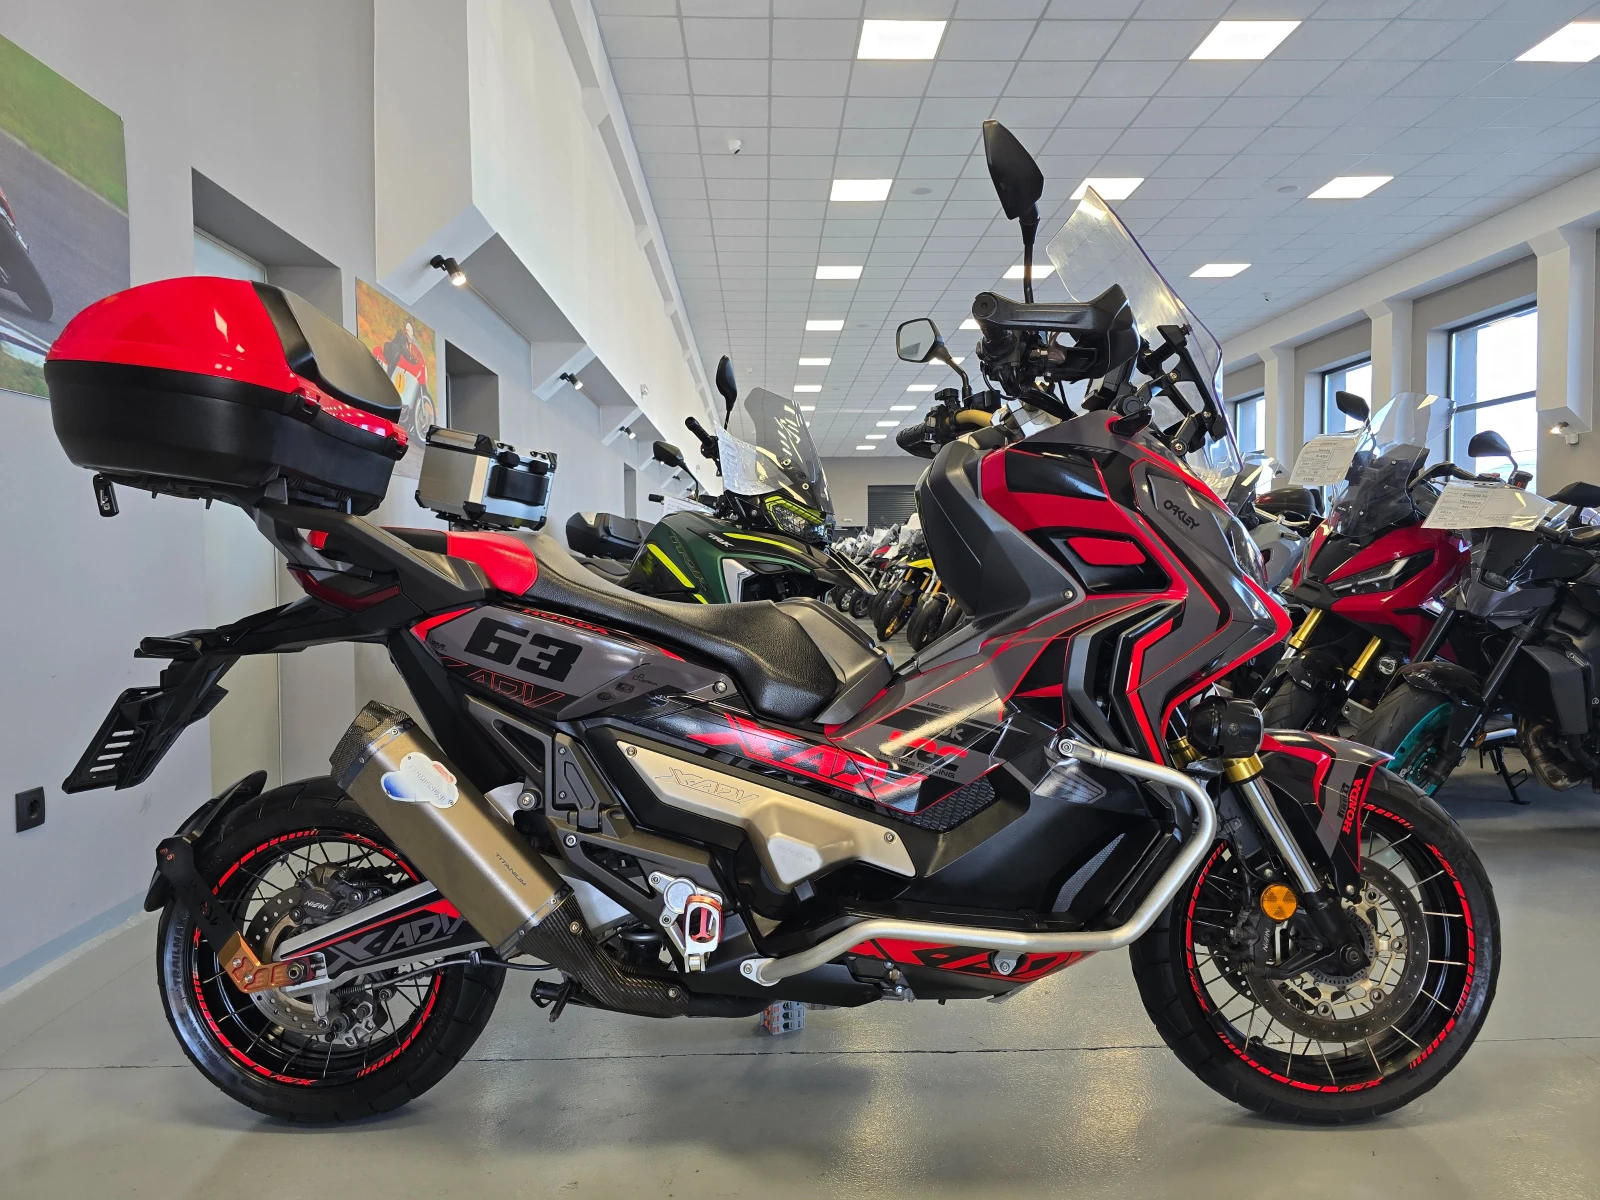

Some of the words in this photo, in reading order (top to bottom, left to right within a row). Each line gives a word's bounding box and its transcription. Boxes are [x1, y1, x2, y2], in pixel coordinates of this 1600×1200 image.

[1164, 500, 1199, 530] OAKLEY
[522, 608, 609, 635] HONDA
[464, 617, 583, 683] 63
[1342, 778, 1364, 835] HONDA
[495, 851, 528, 887] TITANIUM
[326, 912, 466, 975] X-ADV
